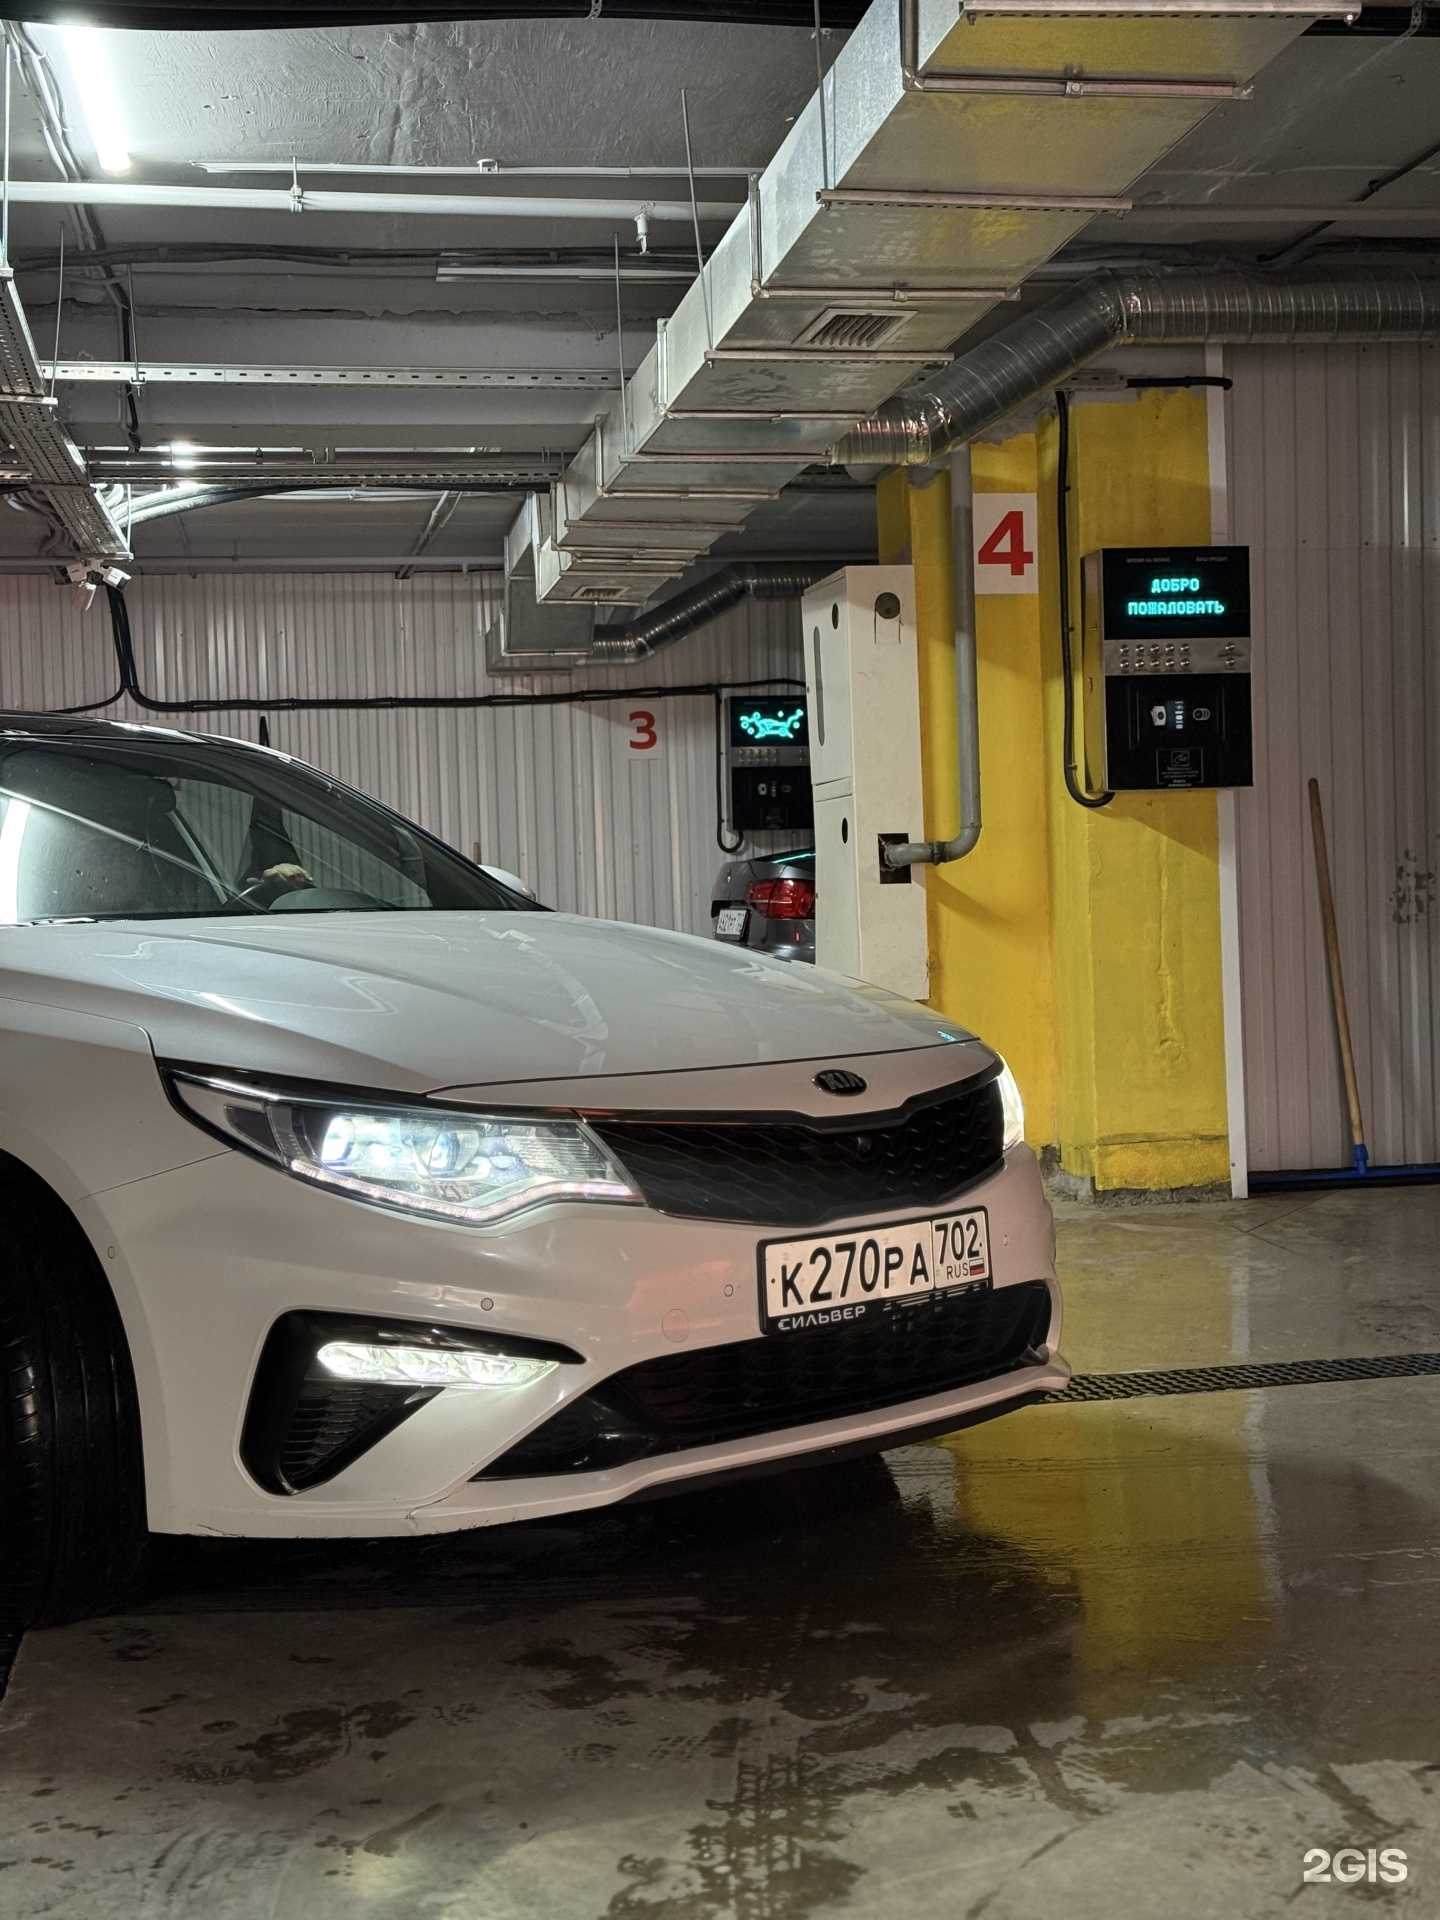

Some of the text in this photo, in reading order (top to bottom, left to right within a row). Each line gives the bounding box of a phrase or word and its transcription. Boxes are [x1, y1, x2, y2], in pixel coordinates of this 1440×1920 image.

[978, 511, 1033, 576] 4
[1151, 578, 1199, 593] ДОБРО
[1127, 600, 1225, 616] ПОЖАЛОВАТЬ
[629, 711, 658, 750] 3
[820, 1071, 864, 1089] KIA
[935, 1218, 980, 1264] 702
[946, 1262, 969, 1280] RUS
[778, 1305, 866, 1331] СИЛЬВЕР
